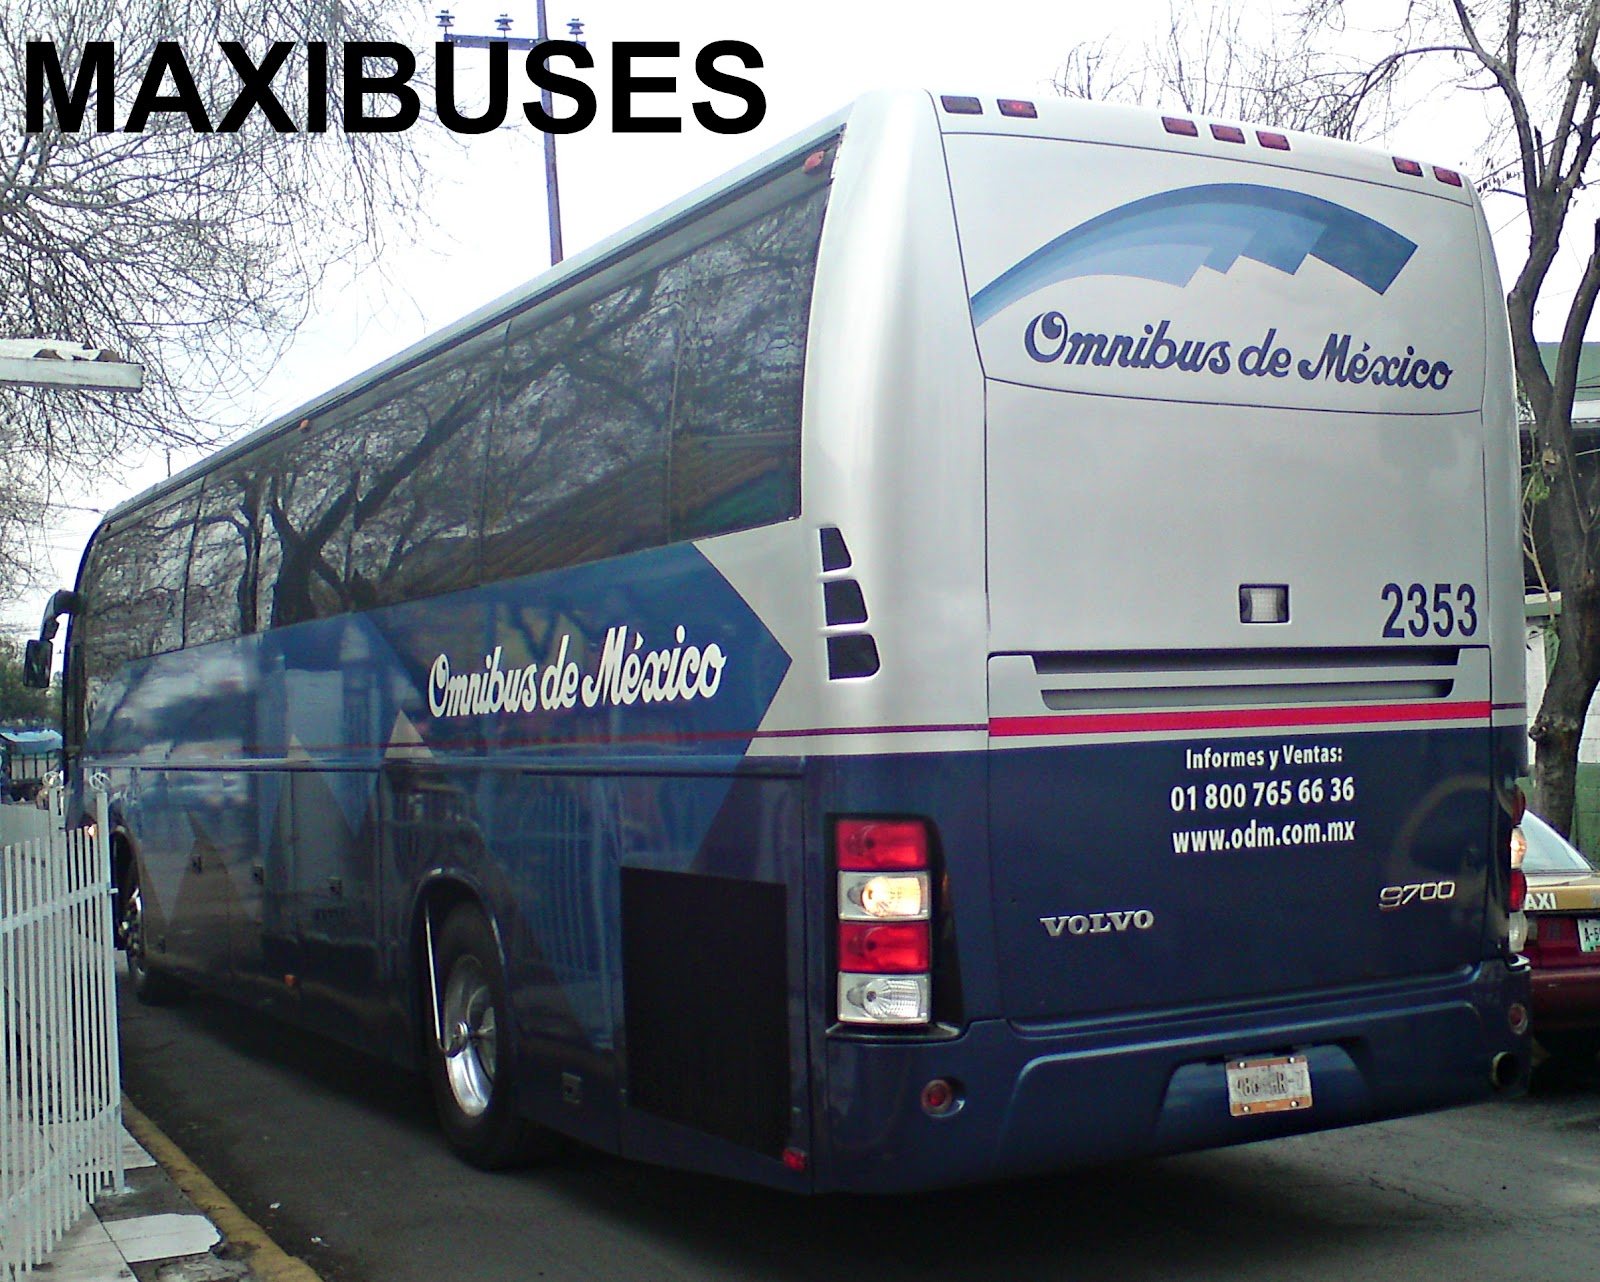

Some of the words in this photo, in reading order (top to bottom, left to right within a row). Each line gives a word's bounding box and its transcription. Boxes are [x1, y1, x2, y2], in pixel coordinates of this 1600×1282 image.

[1024, 311, 1232, 376] Omnibus
[1238, 328, 1291, 378] de
[1296, 333, 1453, 391] México
[1381, 583, 1478, 638] 2353
[428, 646, 538, 718] Omnibus
[540, 635, 580, 710] de
[581, 625, 727, 706] México
[1186, 747, 1265, 770] Informes
[1268, 750, 1280, 771] y
[1282, 744, 1343, 766] Ventas:
[1170, 785, 1197, 812] 01
[1205, 782, 1246, 808] 800
[1252, 779, 1292, 806] 765
[1298, 777, 1324, 804] 66
[1330, 776, 1355, 802] 36
[1172, 818, 1356, 854] www.odm.com.mx
[1378, 880, 1456, 911] 9700
[1523, 892, 1557, 910] AXI
[1040, 909, 1155, 937] VOLVO
